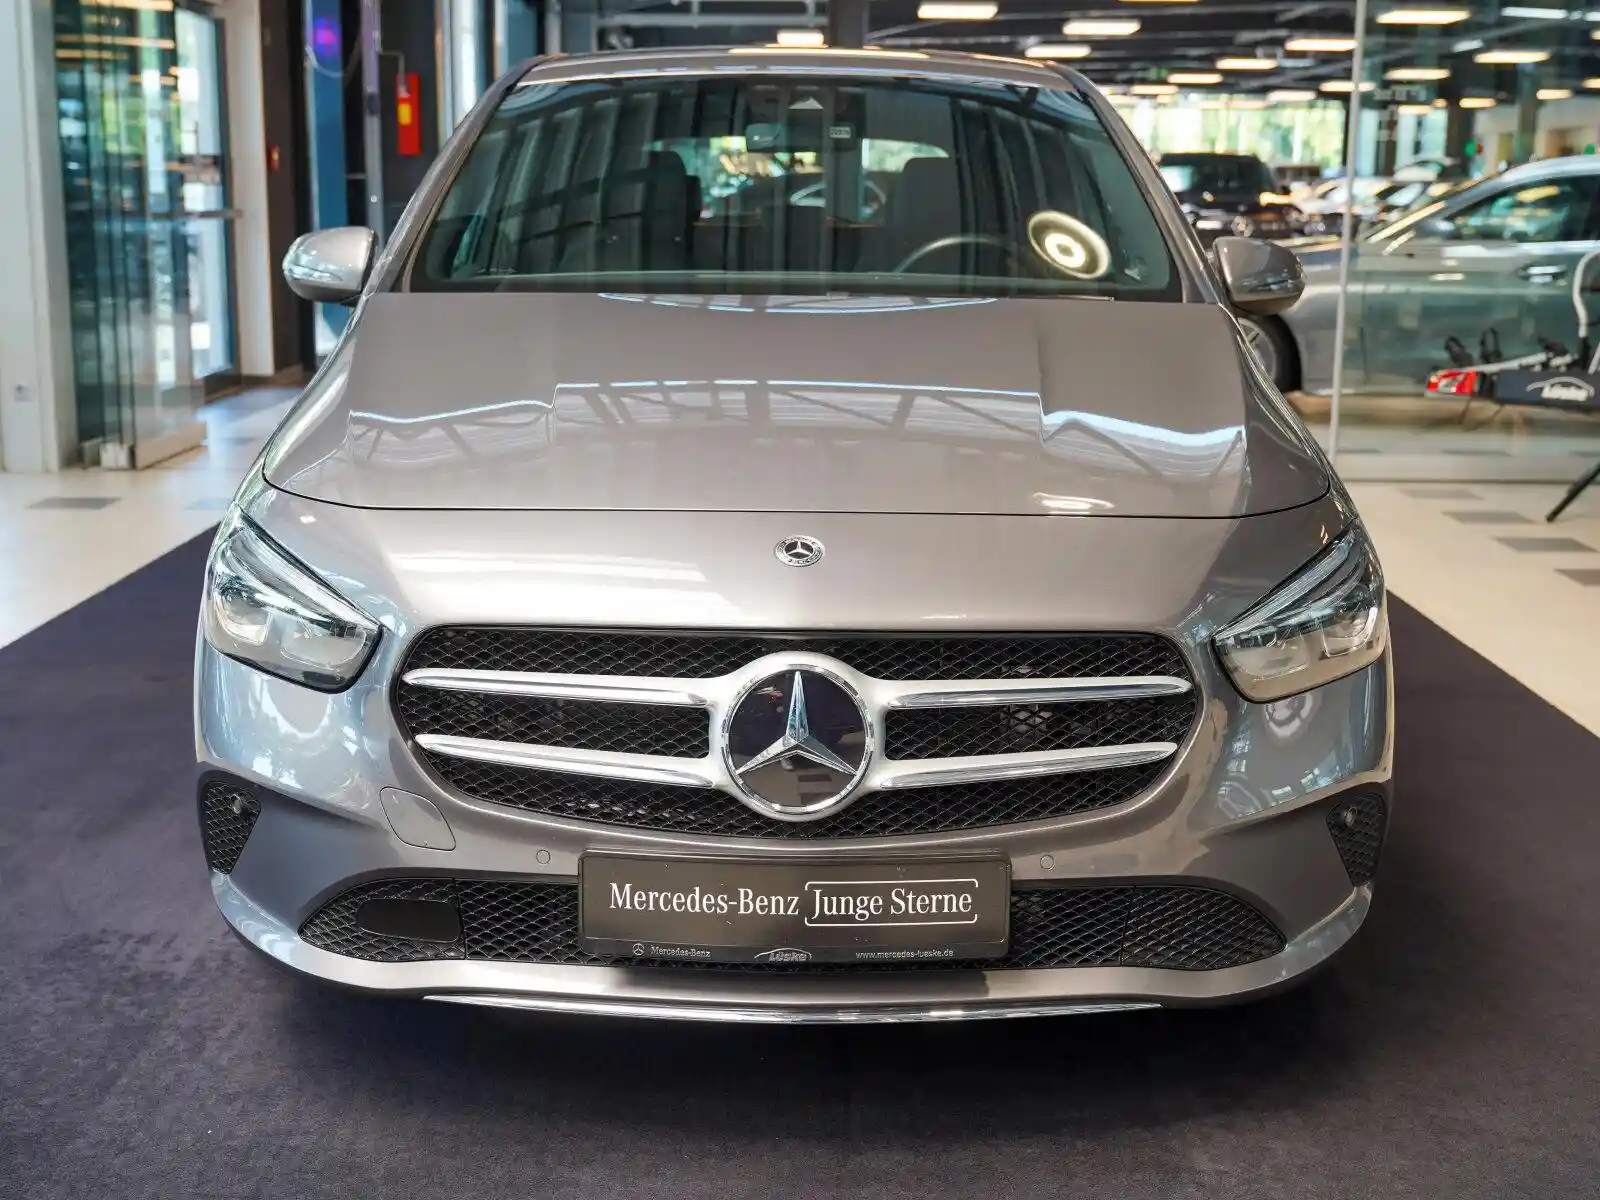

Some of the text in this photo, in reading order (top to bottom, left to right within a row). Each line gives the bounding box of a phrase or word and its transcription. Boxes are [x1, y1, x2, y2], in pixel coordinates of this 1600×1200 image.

[609, 882, 972, 921] Mercedes-Benz Junge Sterne
[650, 944, 711, 958] Mercedes-Benz
[855, 948, 954, 959] www.mercedes-lueske.de
